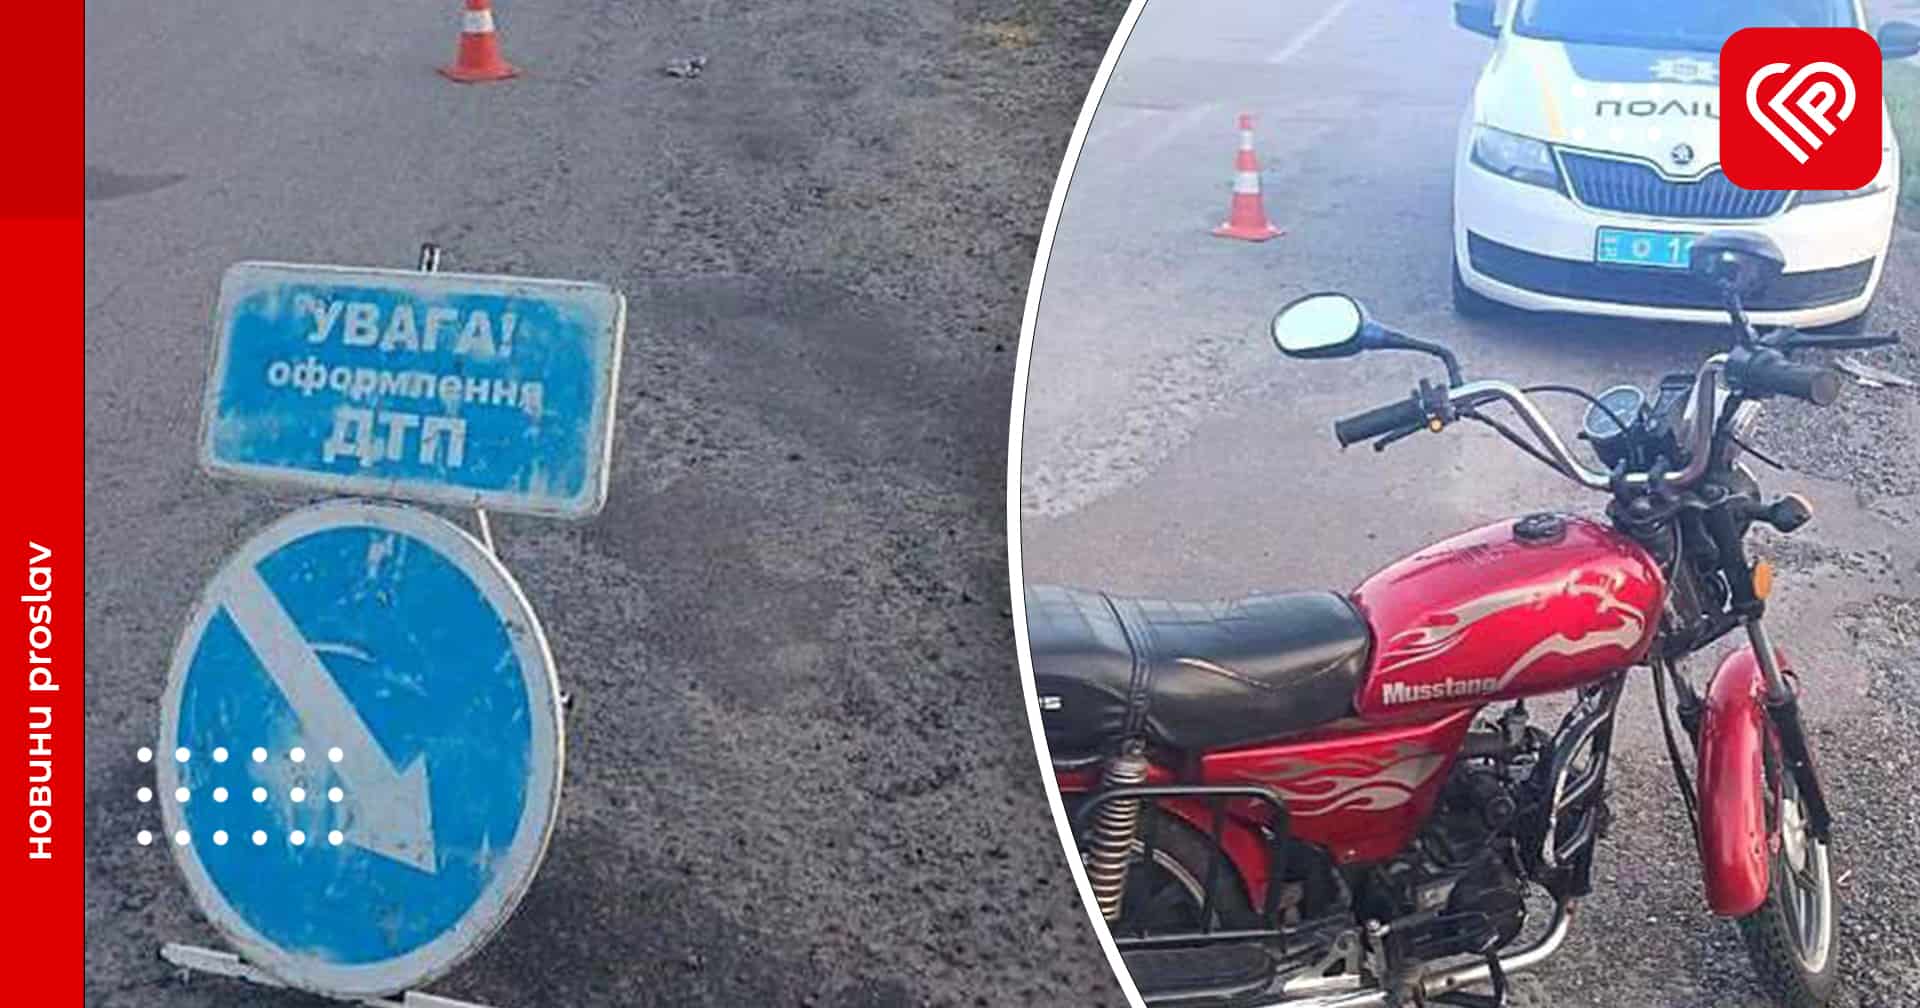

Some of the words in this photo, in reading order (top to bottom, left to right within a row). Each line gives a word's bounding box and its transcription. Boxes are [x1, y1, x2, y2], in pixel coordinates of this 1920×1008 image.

[307, 296, 517, 358] УВАГА!
[267, 356, 544, 414] оформлення
[323, 405, 467, 467] ДТП
[1382, 677, 1497, 705] Musstang
